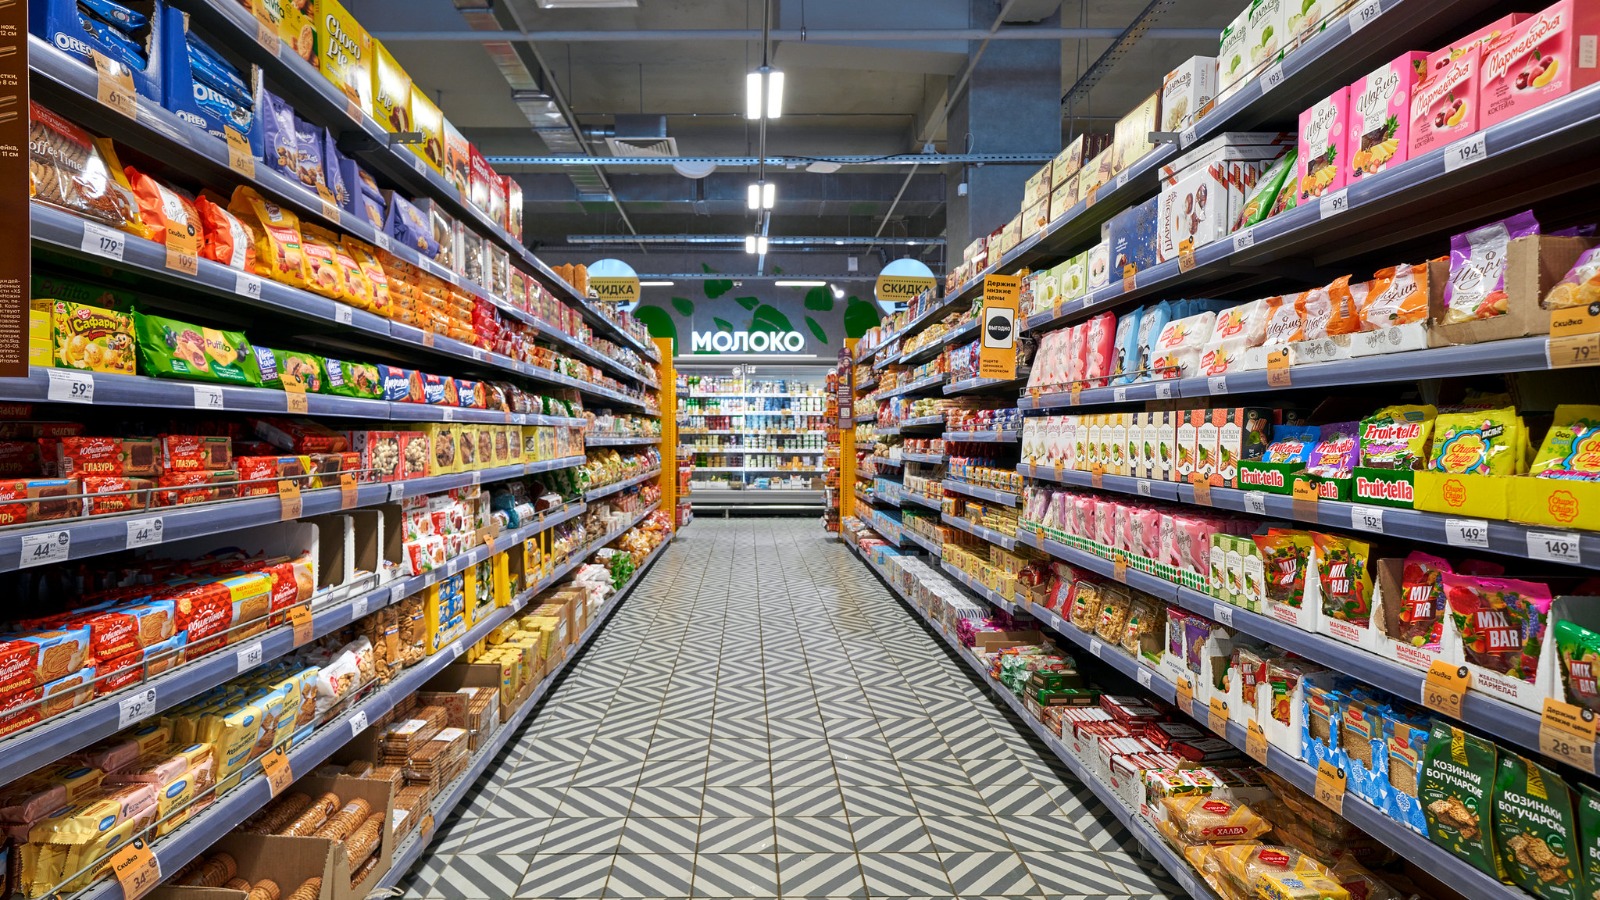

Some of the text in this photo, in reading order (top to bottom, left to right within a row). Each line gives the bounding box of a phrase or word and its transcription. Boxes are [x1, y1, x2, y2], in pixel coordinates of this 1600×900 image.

[1360, 5, 1376, 21] 193
[325, 14, 361, 60] Choco
[55, 32, 93, 58] OREO
[326, 38, 349, 69] Pie
[1268, 73, 1280, 85] 193
[109, 91, 121, 104] 61
[193, 83, 236, 109] OREO
[1487, 100, 1515, 116] КОКТЕЙЛЬ
[175, 109, 207, 129] OREO
[1459, 143, 1479, 160] 194
[60, 149, 82, 171] Time
[1332, 198, 1342, 209] 99
[168, 228, 186, 240] Скидка
[100, 237, 117, 251] 179
[1237, 238, 1245, 246] 89
[178, 254, 193, 267] 109
[248, 283, 257, 293] 99
[986, 280, 1017, 289] Держим
[73, 318, 116, 332] Сафари
[1552, 318, 1583, 328] Скидка
[691, 331, 805, 352] МОЛОКО
[1572, 345, 1590, 360] 79
[72, 383, 86, 395] 59
[209, 394, 218, 404] 72
[1364, 422, 1420, 441] Fruit-tella
[1316, 438, 1354, 455] Fruit-tella
[1451, 443, 1481, 456] Chupa
[83, 462, 114, 472] ГЛАЗУРЬ
[175, 459, 198, 468] ГЛАЗУРЬ
[1445, 452, 1473, 467] Chups
[1241, 467, 1285, 488] Fruit-tella
[1294, 487, 1308, 495] Скидка
[1357, 476, 1414, 503] Fruit-tella
[1445, 484, 1463, 493] Chupa
[1445, 492, 1463, 502] Chups
[1551, 497, 1575, 507] Chupa
[100, 501, 124, 511] ГЛАЗУРЬ
[1252, 501, 1262, 511] 152
[1551, 504, 1575, 515] Chups
[1363, 515, 1377, 528] 152
[136, 529, 148, 540] 44
[1460, 527, 1479, 540] 149
[33, 543, 50, 557] 44
[1545, 541, 1569, 555] 149
[1278, 558, 1297, 576] MIX
[1328, 564, 1347, 578] MIX
[1331, 578, 1350, 595] BAR
[1410, 585, 1432, 602] MIX
[1273, 604, 1298, 619] МАРМЕЛАД
[188, 609, 226, 633] Юбилейное
[1477, 611, 1509, 628] MIX
[101, 623, 132, 643] Юбилейное
[1329, 620, 1360, 637] МАРМЕЛАД
[1489, 629, 1520, 649] BAR
[247, 652, 258, 662] 154
[1396, 643, 1431, 663] МАРМЕЛАД
[1430, 668, 1451, 681] Скидка
[1571, 662, 1591, 678] MIX
[1478, 672, 1518, 690] ЖЕВАТЕЛЬНЫЙ
[1478, 678, 1518, 699] МАРМЕЛАД
[1579, 678, 1598, 694] BAR
[1429, 693, 1443, 705] 69
[129, 703, 142, 718] 29
[1546, 706, 1577, 721] Держим
[1545, 714, 1592, 735] низкие цены
[1552, 739, 1569, 755] 28
[1319, 767, 1335, 780] Скидка
[1433, 758, 1482, 785] КОЗИНАКИ
[1426, 767, 1484, 799] БОГУЧАРСКИЕ
[1321, 789, 1332, 801] 59
[1503, 790, 1562, 822] КОЗИНАКИ
[1498, 800, 1567, 838] БОГУЧАРСКИЕ
[1217, 827, 1244, 836] ХАЛВА
[117, 854, 138, 872] Скидка
[133, 874, 147, 890] 34
